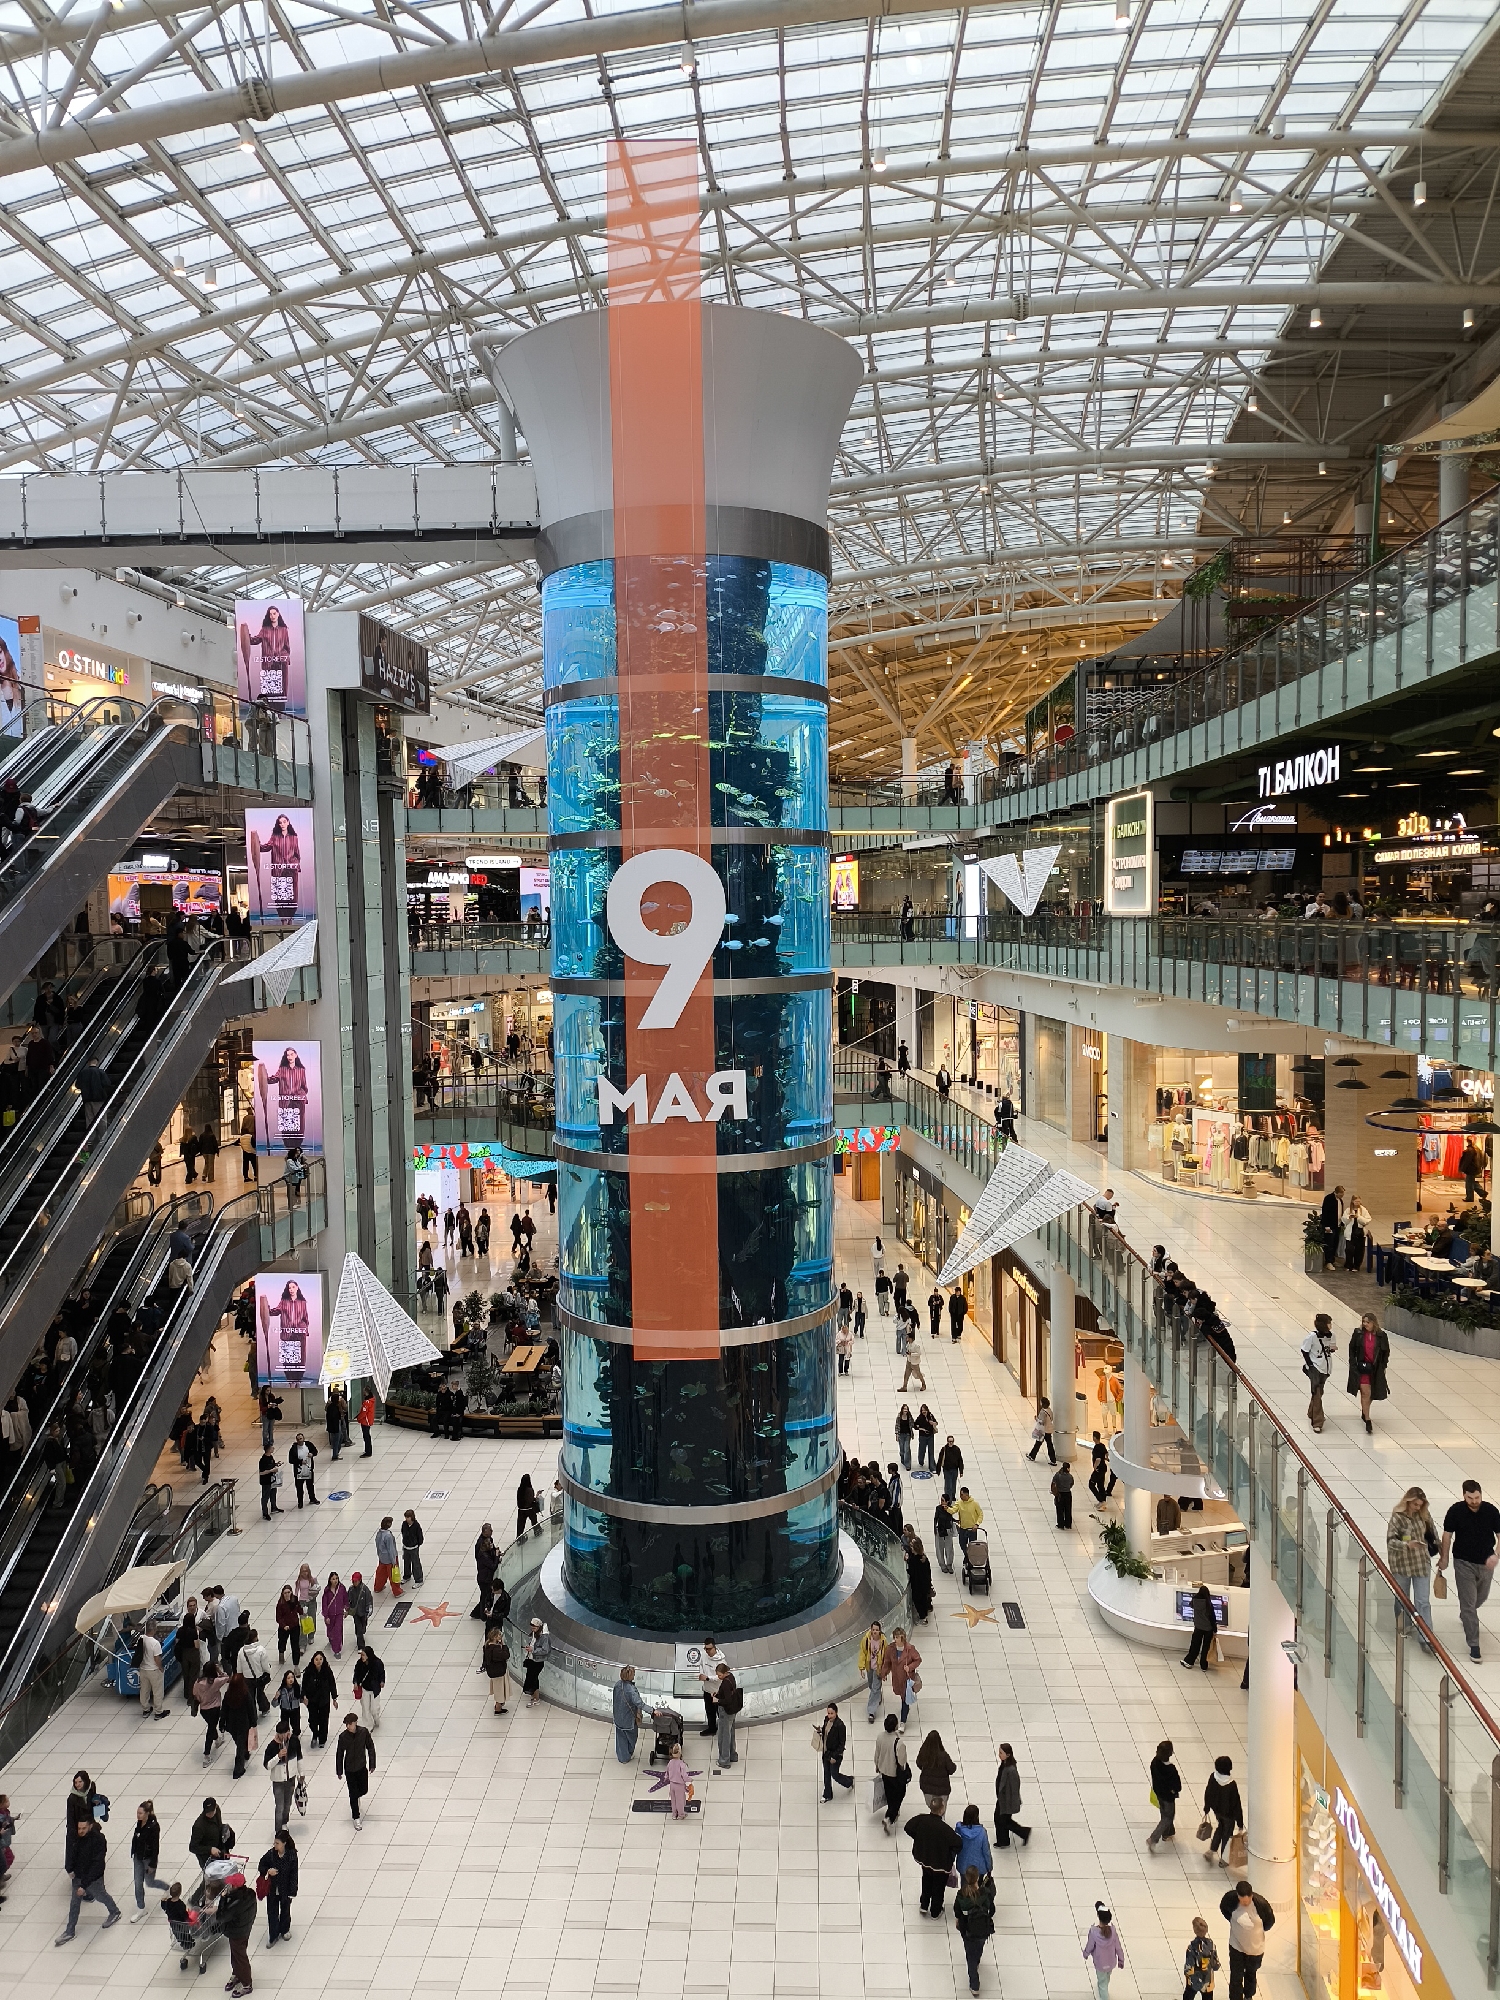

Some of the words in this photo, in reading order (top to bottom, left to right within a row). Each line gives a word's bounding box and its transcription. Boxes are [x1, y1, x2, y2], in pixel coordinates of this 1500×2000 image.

[108, 664, 130, 686] kids
[378, 658, 415, 693] HAZZYS
[1275, 745, 1340, 795] БАЛКОН
[1116, 821, 1140, 838] БАЛКОН
[1400, 845, 1449, 861] ПОЛЕЗНАЯ
[1451, 842, 1481, 856] КУХНЯ
[428, 871, 469, 884] AMAZING
[470, 873, 488, 885] RED
[606, 849, 726, 1029] 9
[598, 1069, 748, 1124] МАЯ
